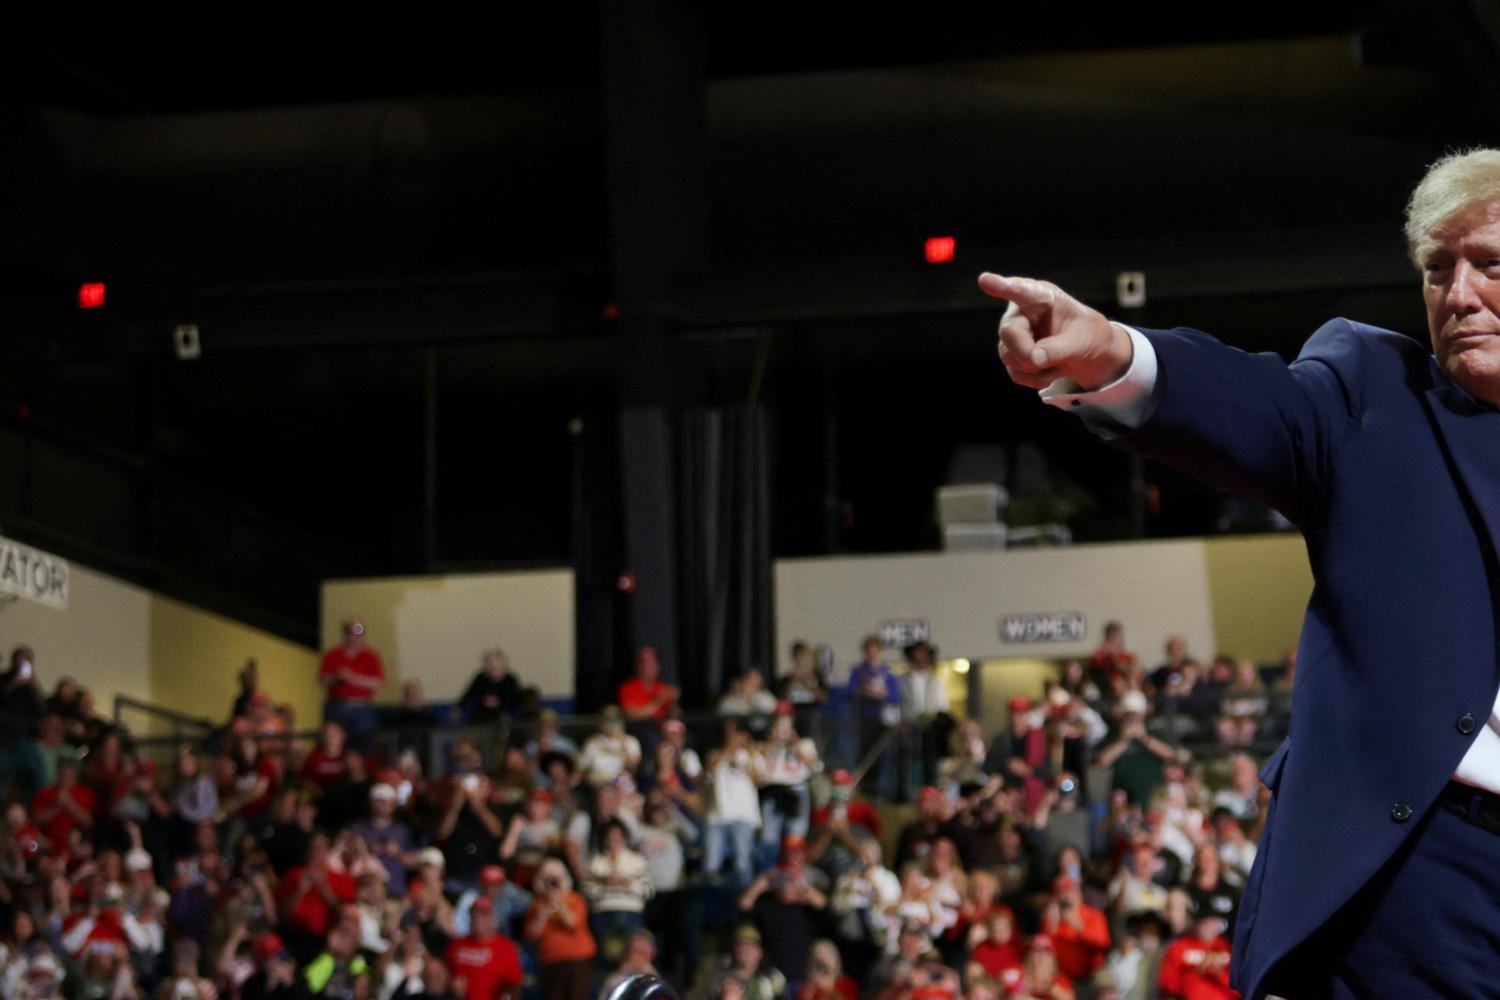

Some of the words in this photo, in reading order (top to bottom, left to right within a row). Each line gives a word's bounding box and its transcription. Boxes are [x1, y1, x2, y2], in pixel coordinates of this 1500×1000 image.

[0, 548, 66, 600] ATOR
[883, 622, 929, 642] MEN
[1006, 614, 1085, 640] WOMEN
